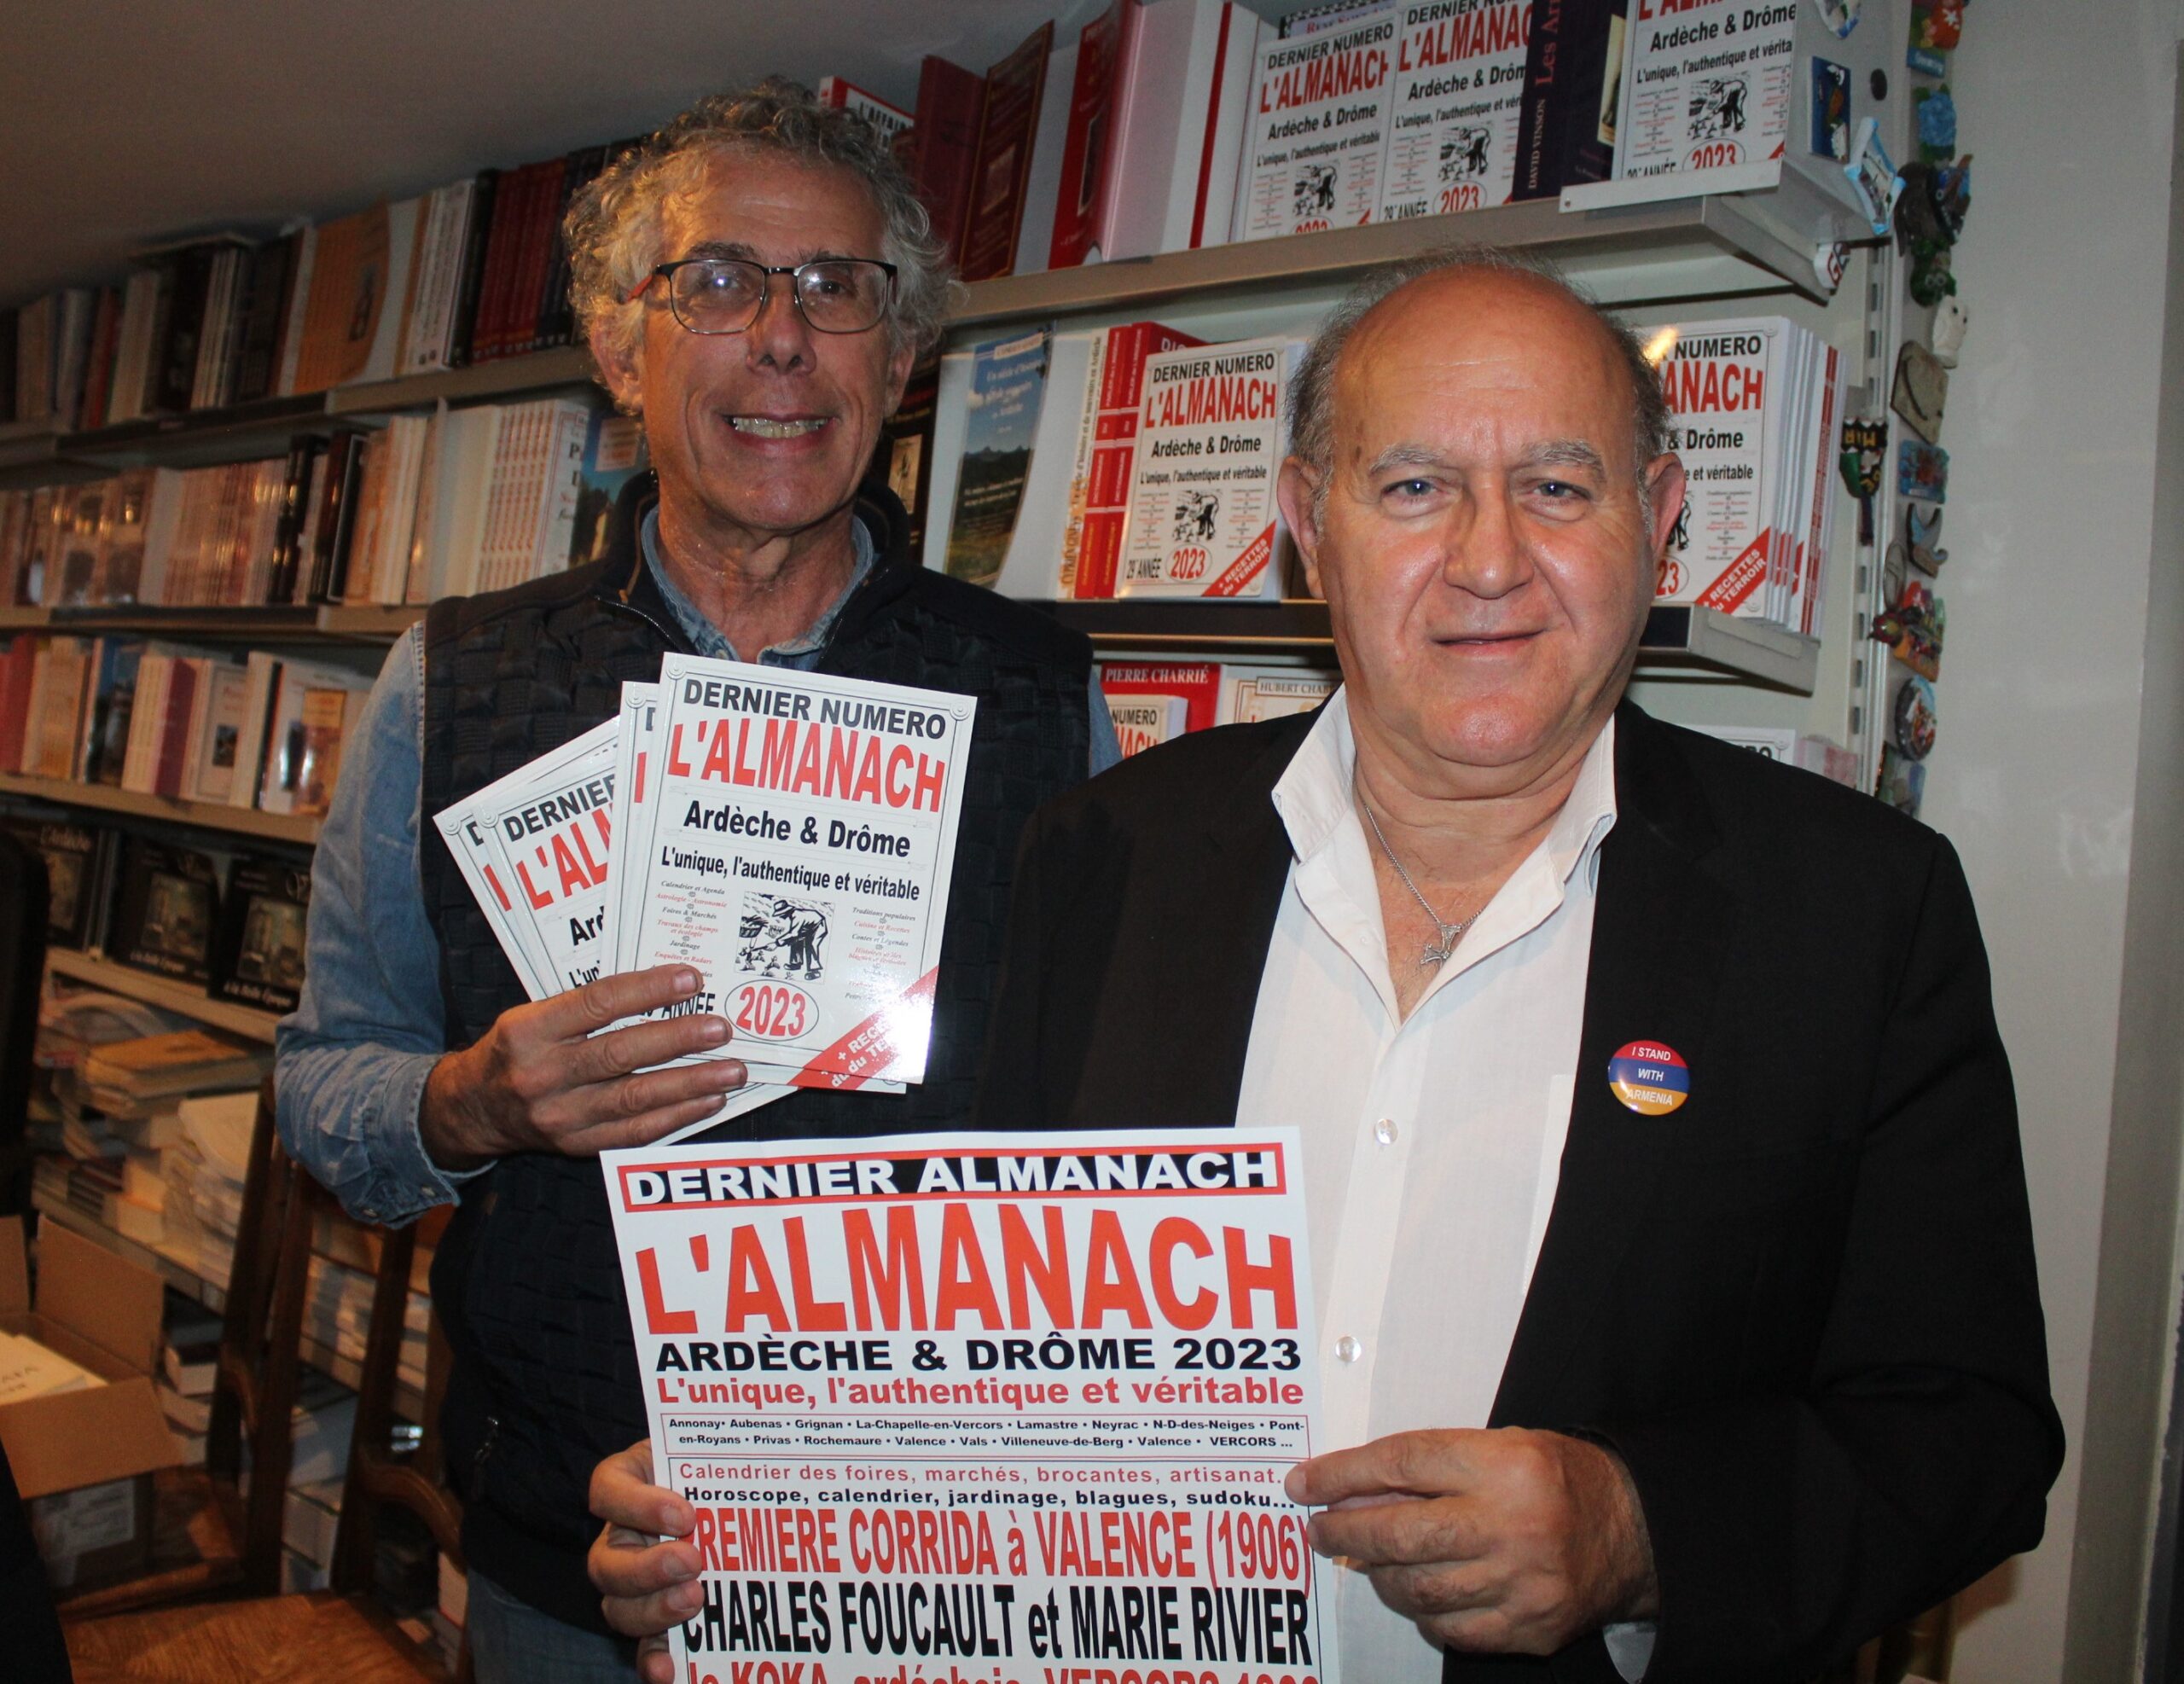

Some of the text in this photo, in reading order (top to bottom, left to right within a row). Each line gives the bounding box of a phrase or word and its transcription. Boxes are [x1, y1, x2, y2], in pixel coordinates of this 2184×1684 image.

[1408, 0, 1477, 26] DERNIER
[1268, 23, 1393, 70] DERNIER NUMERO
[1398, 3, 1533, 72] L'ALMANAC
[1650, 21, 1718, 53] Ardèche
[1724, 14, 1736, 35] &
[1637, 39, 1792, 84] L'unique, l'authentique et vérita
[1409, 62, 1525, 101] Ardèche & Drôm
[1323, 111, 1332, 128] &
[1337, 104, 1377, 125] Drôme
[1495, 98, 1502, 110] et
[1675, 335, 1761, 360] NUMERO
[1153, 353, 1275, 383] DERNIER NUMERO
[1664, 360, 1763, 415] ANACH
[1145, 376, 1276, 428] L'ALMANACH
[1151, 434, 1261, 457] Ardèche & Drôme
[1687, 427, 1744, 449] Drôme
[1223, 468, 1231, 480] et
[1233, 465, 1267, 479] véritable
[1693, 467, 1703, 480] et
[1707, 464, 1753, 480] véritable
[1170, 548, 1206, 579] 2023
[1225, 538, 1267, 583] RECETTES
[1235, 547, 1270, 584] TERROIR
[1656, 559, 1680, 595] 23
[1710, 549, 1760, 601] RECETTES
[1722, 558, 1766, 602] TERROIR
[1106, 665, 1209, 683] PIERRE CHARRIÉ
[1260, 682, 1298, 693] HUBERT
[683, 679, 945, 740] DERNIER NUMERO
[1112, 710, 1157, 725] NUMERO
[668, 718, 945, 812] L'ALMANACH
[683, 800, 910, 857] Ardèche & Drôme
[661, 880, 694, 890] Calendrier
[662, 846, 920, 900] L'unique, l'authentique et véritable
[691, 911, 717, 920] Marchés
[853, 907, 915, 921] Traditions populaires
[695, 925, 718, 933] champs
[670, 940, 700, 949] Jardinage
[691, 955, 712, 964] Radars
[736, 985, 805, 1037] 2023
[848, 1057, 867, 1073] du
[1631, 1047, 1670, 1061] I STAND
[1638, 1068, 1664, 1082] WITH
[1626, 1089, 1673, 1106] ARMENIA
[625, 1150, 1278, 1205] DERNIER ALMANACH
[636, 1203, 1298, 1335] L'ALMANACH
[656, 1331, 1301, 1372] ARDÈCHE & DRÔME 2023
[657, 1376, 1304, 1410] L'unique, l'authentique et véritable
[730, 1419, 781, 1429] Aubenas
[795, 1420, 843, 1431] Grignan
[857, 1420, 1002, 1431] La-Chapelle-en-Vercors
[1017, 1420, 1077, 1430] Lamastre
[1092, 1420, 1139, 1431] Neyrac
[1153, 1420, 1255, 1431] N-D-des-Neiges
[1269, 1420, 1304, 1430] Pont-
[679, 1435, 1276, 1449] en-Royans Privas Rochemaure Valence Vals Villeneuve-de-Berg Valence VERCORS
[680, 1463, 790, 1480] Calendrier
[799, 1465, 836, 1480] des
[845, 1465, 915, 1484] foires,
[926, 1466, 1028, 1484] marchés,
[1037, 1466, 1159, 1484] brocantes,
[684, 1487, 1295, 1508] Horoscope, calendrier, jardinage, blagues, sudoku...
[680, 1507, 1311, 1600] REMIERE CORRIDA à VALENCE (1906)
[839, 1582, 1014, 1657] FOUCAULT
[1028, 1587, 1063, 1658] et
[1070, 1586, 1182, 1660] MARIE
[1191, 1587, 1312, 1665] RIVIER
